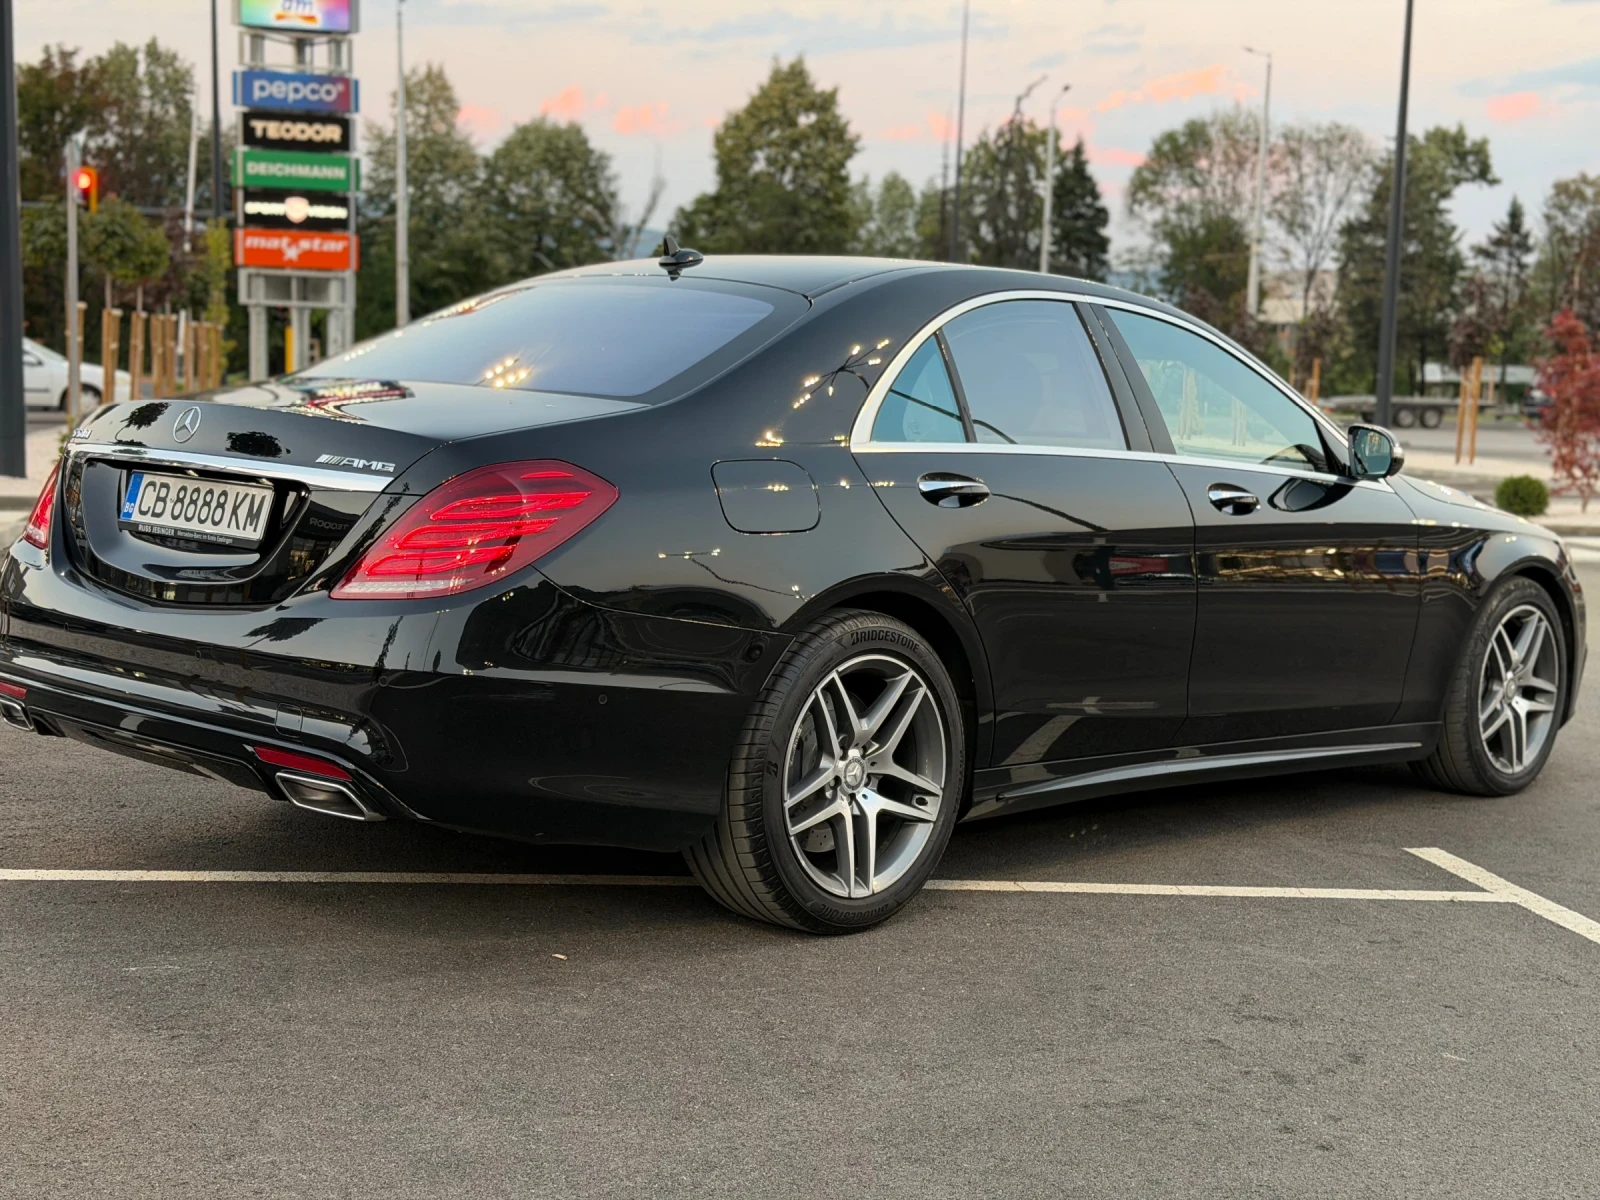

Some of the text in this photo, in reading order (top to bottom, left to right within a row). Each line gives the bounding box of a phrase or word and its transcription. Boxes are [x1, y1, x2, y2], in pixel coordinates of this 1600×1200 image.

[253, 78, 338, 104] pepco
[249, 119, 343, 143] TEODOR
[246, 160, 347, 180] DEICHMANN
[123, 502, 135, 513] BG
[138, 524, 151, 533] RUSS
[850, 629, 920, 654] BRIDGESTONE
